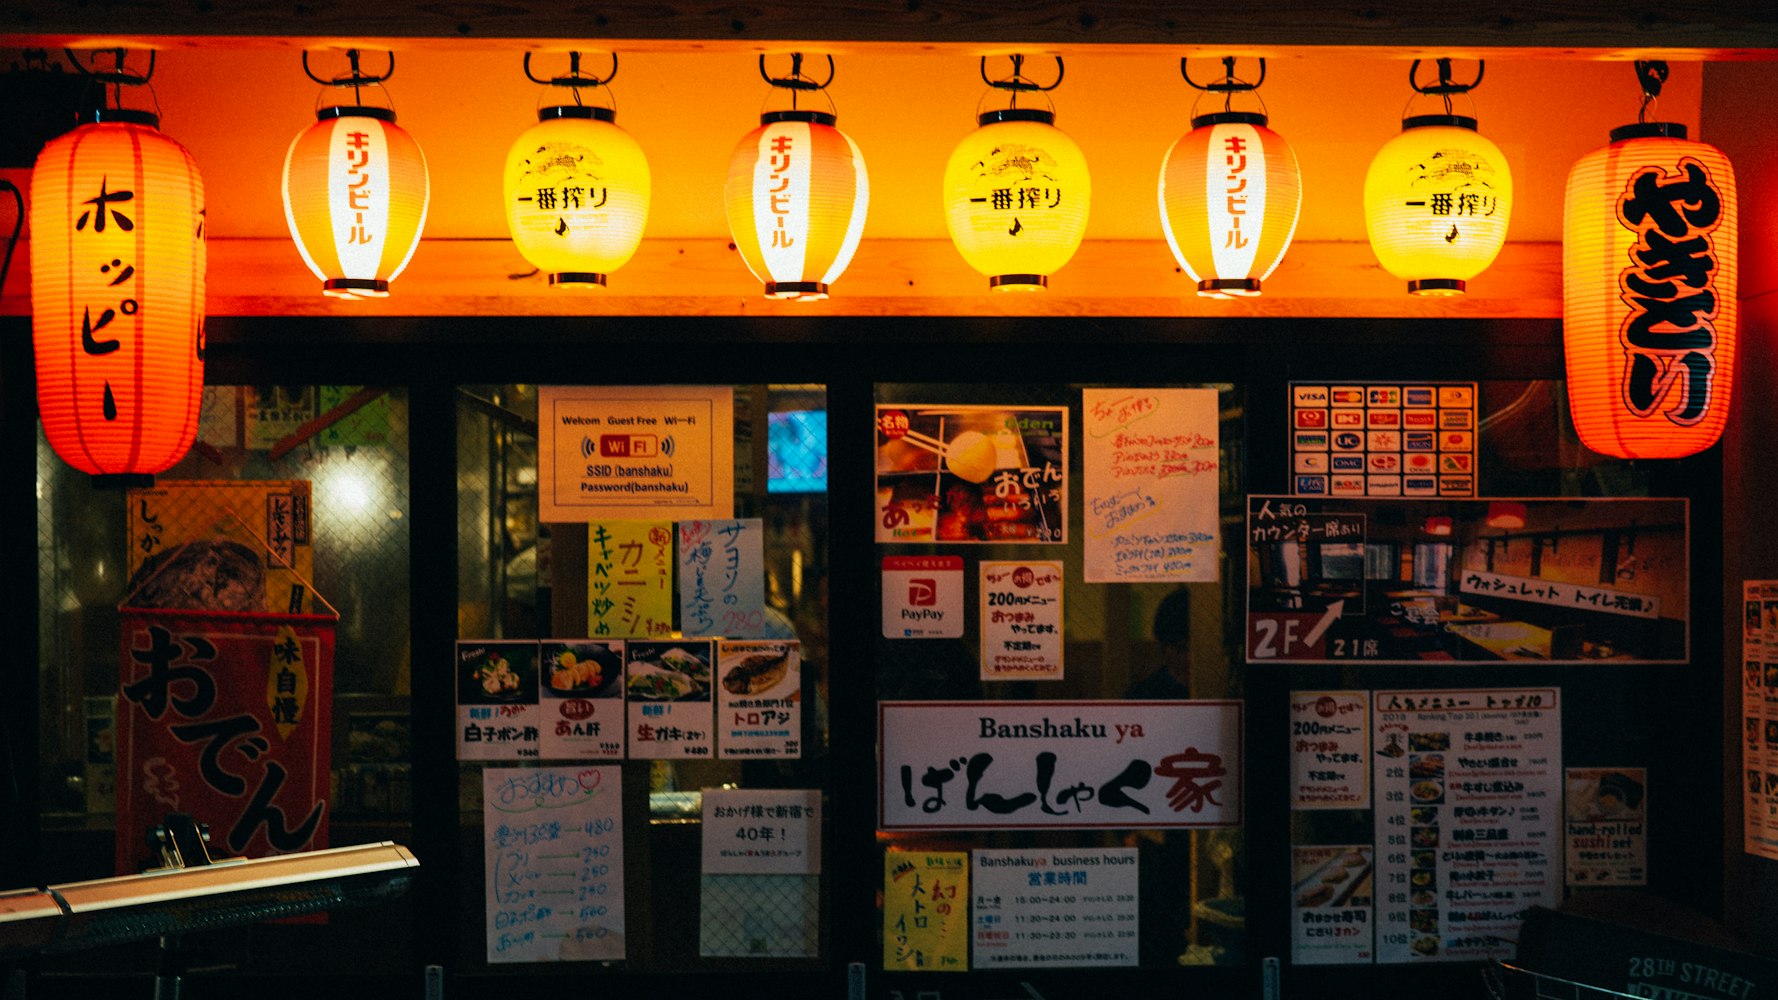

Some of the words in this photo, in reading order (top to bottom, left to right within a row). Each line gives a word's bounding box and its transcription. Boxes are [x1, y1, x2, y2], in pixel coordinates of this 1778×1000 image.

[346, 132, 373, 246] キリンビール
[769, 135, 794, 249] キリンビール
[1224, 136, 1249, 249] キリンビール
[517, 186, 608, 210] 一番搾り
[969, 187, 1062, 210] 一番搾り
[1405, 192, 1497, 217] 一番搾り
[75, 173, 139, 421] ホッピー
[1621, 161, 1723, 422] やきとり
[1299, 393, 1326, 401] VISA
[562, 415, 601, 426] Welcom
[607, 415, 635, 426] Guest
[637, 415, 658, 426] Free
[881, 414, 909, 430] 名物
[1004, 417, 1055, 430] Oden
[608, 440, 625, 454] Wi
[586, 464, 612, 478] SSID
[614, 463, 674, 478] (banshaku)
[993, 461, 1062, 498] おでん
[580, 481, 689, 495] Password(banshaku)
[1003, 489, 1061, 513] いろいろ
[1258, 499, 1307, 520] 人気の
[1252, 519, 1361, 542] カウンター席あり
[1466, 574, 1560, 599] ウォシュレット
[988, 592, 1057, 607] 200円メニュー
[901, 608, 944, 621] PayPay
[991, 610, 1035, 623] おつまみ
[1253, 618, 1301, 659] 2F
[1333, 639, 1379, 657] 21席
[271, 635, 301, 725] 味自慢
[1387, 695, 1471, 711] 人気メニュー
[734, 709, 791, 726] トロアジ
[464, 723, 539, 742] 白子ポン酢
[555, 719, 601, 737] あん肝
[978, 717, 1106, 739] Banshaku
[1114, 721, 1145, 744] ya
[1293, 721, 1361, 735] 200円メニュー
[122, 624, 326, 854] おでん
[1295, 740, 1339, 753] おつまみ
[900, 746, 1228, 814] ばんしゃく家
[1386, 767, 1404, 777] 2位
[1385, 790, 1404, 801] 3位
[713, 805, 815, 819] おかげ様で新宿で
[1387, 814, 1406, 825] 4位
[735, 826, 786, 842] 40年！
[1568, 824, 1643, 836] hand-rolled
[1388, 834, 1406, 845] 5位
[1572, 834, 1611, 849] sushi
[1612, 837, 1632, 848] set
[980, 856, 1048, 867] Banshakuya
[1052, 855, 1101, 867] business
[1103, 855, 1136, 866] hours
[1027, 871, 1088, 886] 営業時間
[1389, 873, 1406, 883] 7位
[1302, 910, 1367, 923] おまかせ寿司
[1388, 912, 1406, 922] 9位
[1383, 934, 1408, 944] 10位
[1628, 956, 1676, 978] 28TH
[1680, 961, 1757, 1000] STREET
